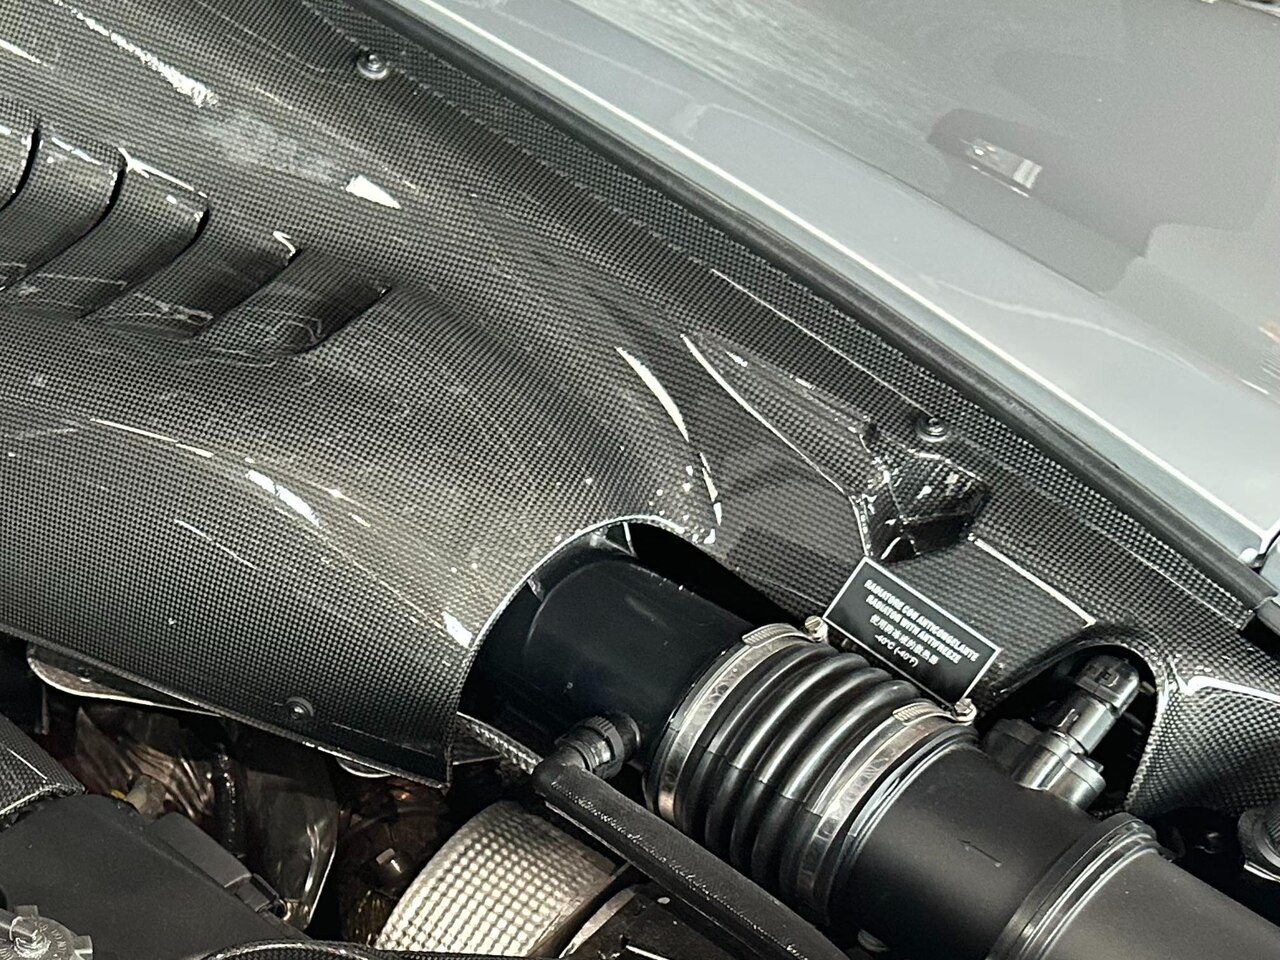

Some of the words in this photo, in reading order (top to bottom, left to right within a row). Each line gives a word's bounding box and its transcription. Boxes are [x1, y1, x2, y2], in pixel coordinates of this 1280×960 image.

[864, 579, 904, 610] RADIATORE
[902, 605, 920, 620] CON
[917, 614, 980, 662] ANTICONGELANTE
[865, 595, 902, 623] RADIATOR
[900, 618, 921, 635] WITH
[918, 631, 962, 664] ANTIFREEZE
